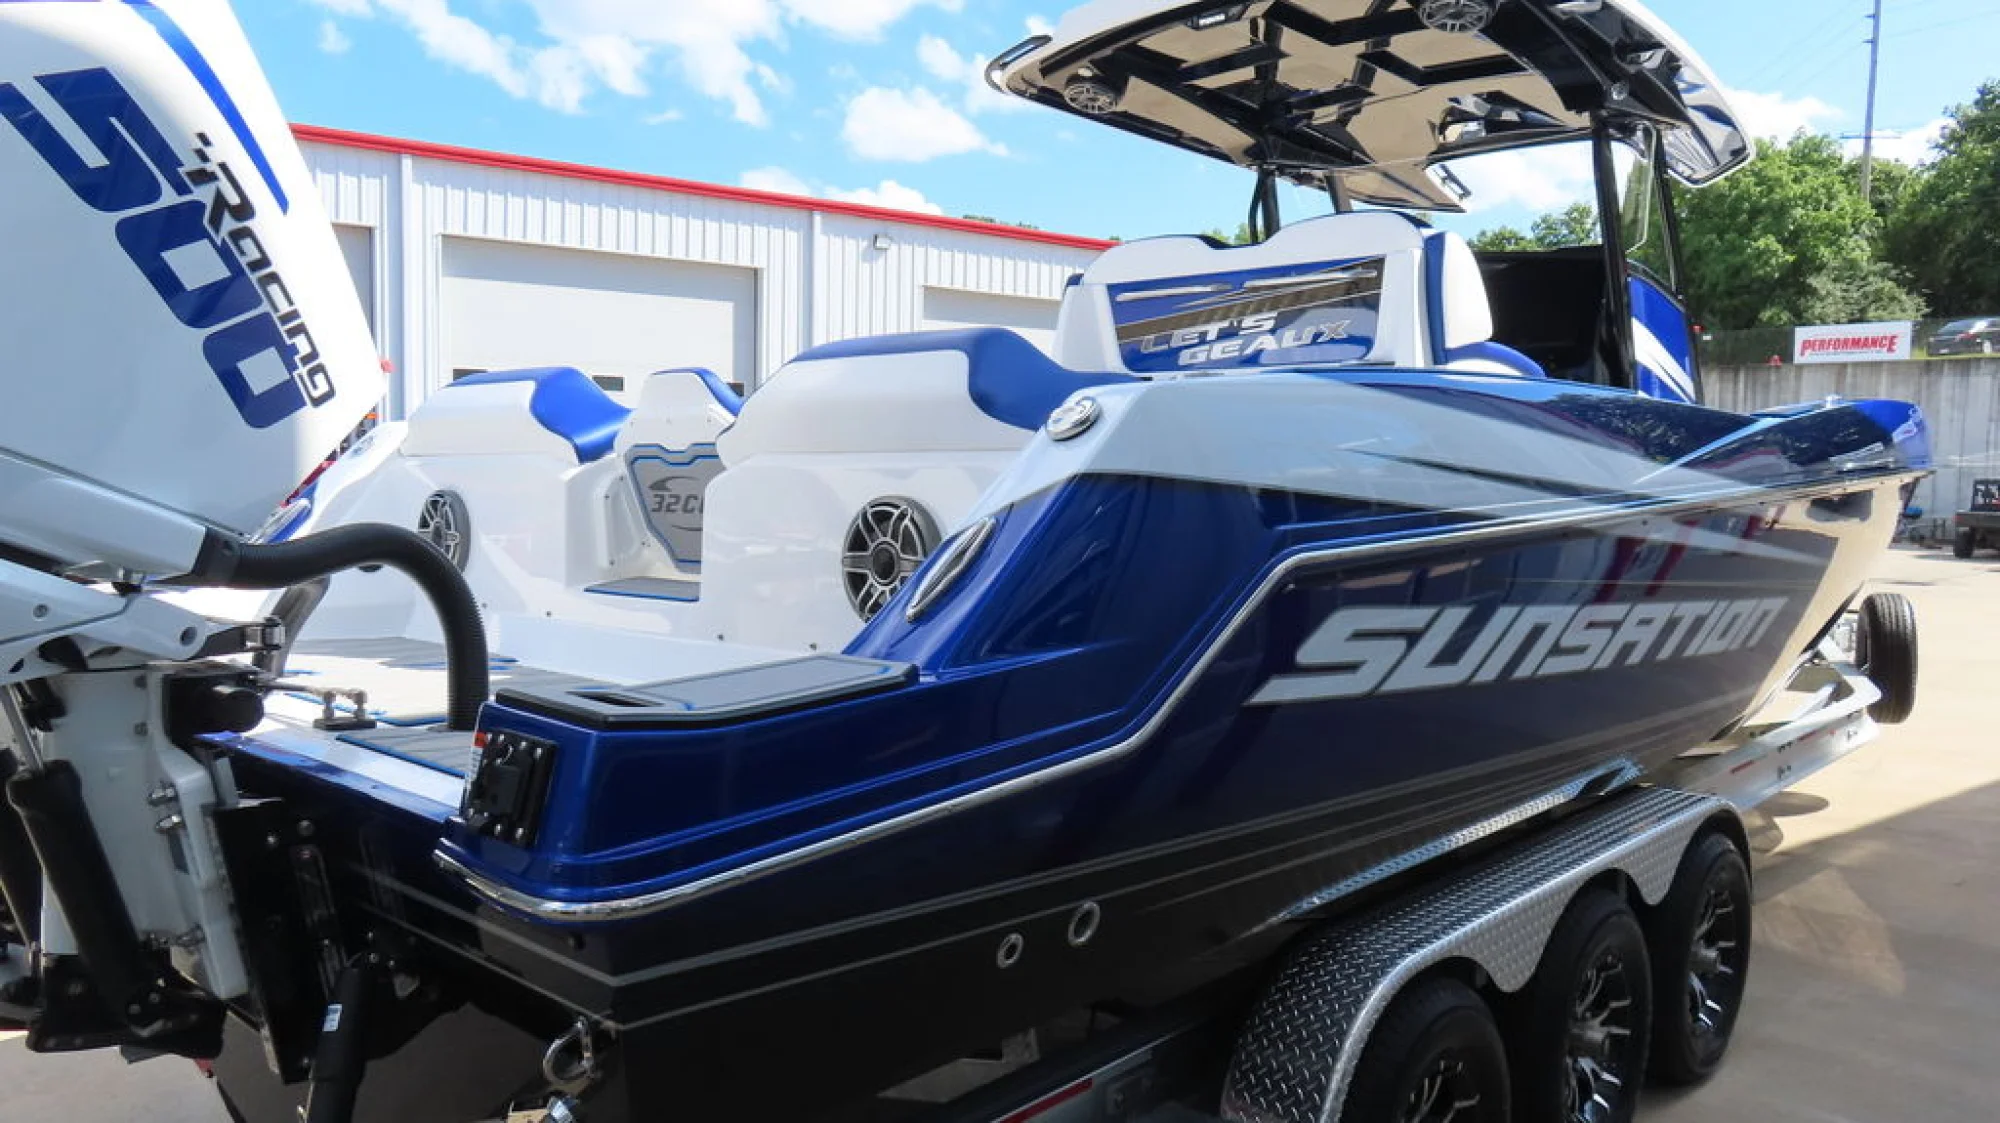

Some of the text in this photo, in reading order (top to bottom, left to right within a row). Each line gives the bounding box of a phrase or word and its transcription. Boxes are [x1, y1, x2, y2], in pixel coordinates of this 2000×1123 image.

[0, 67, 307, 429] 500
[187, 160, 336, 408] Racing
[1140, 311, 1279, 354] LET'S
[1177, 319, 1351, 366] GEAUX
[1799, 335, 1898, 357] PERFORMANCE
[1245, 597, 1789, 706] SUNSATION
